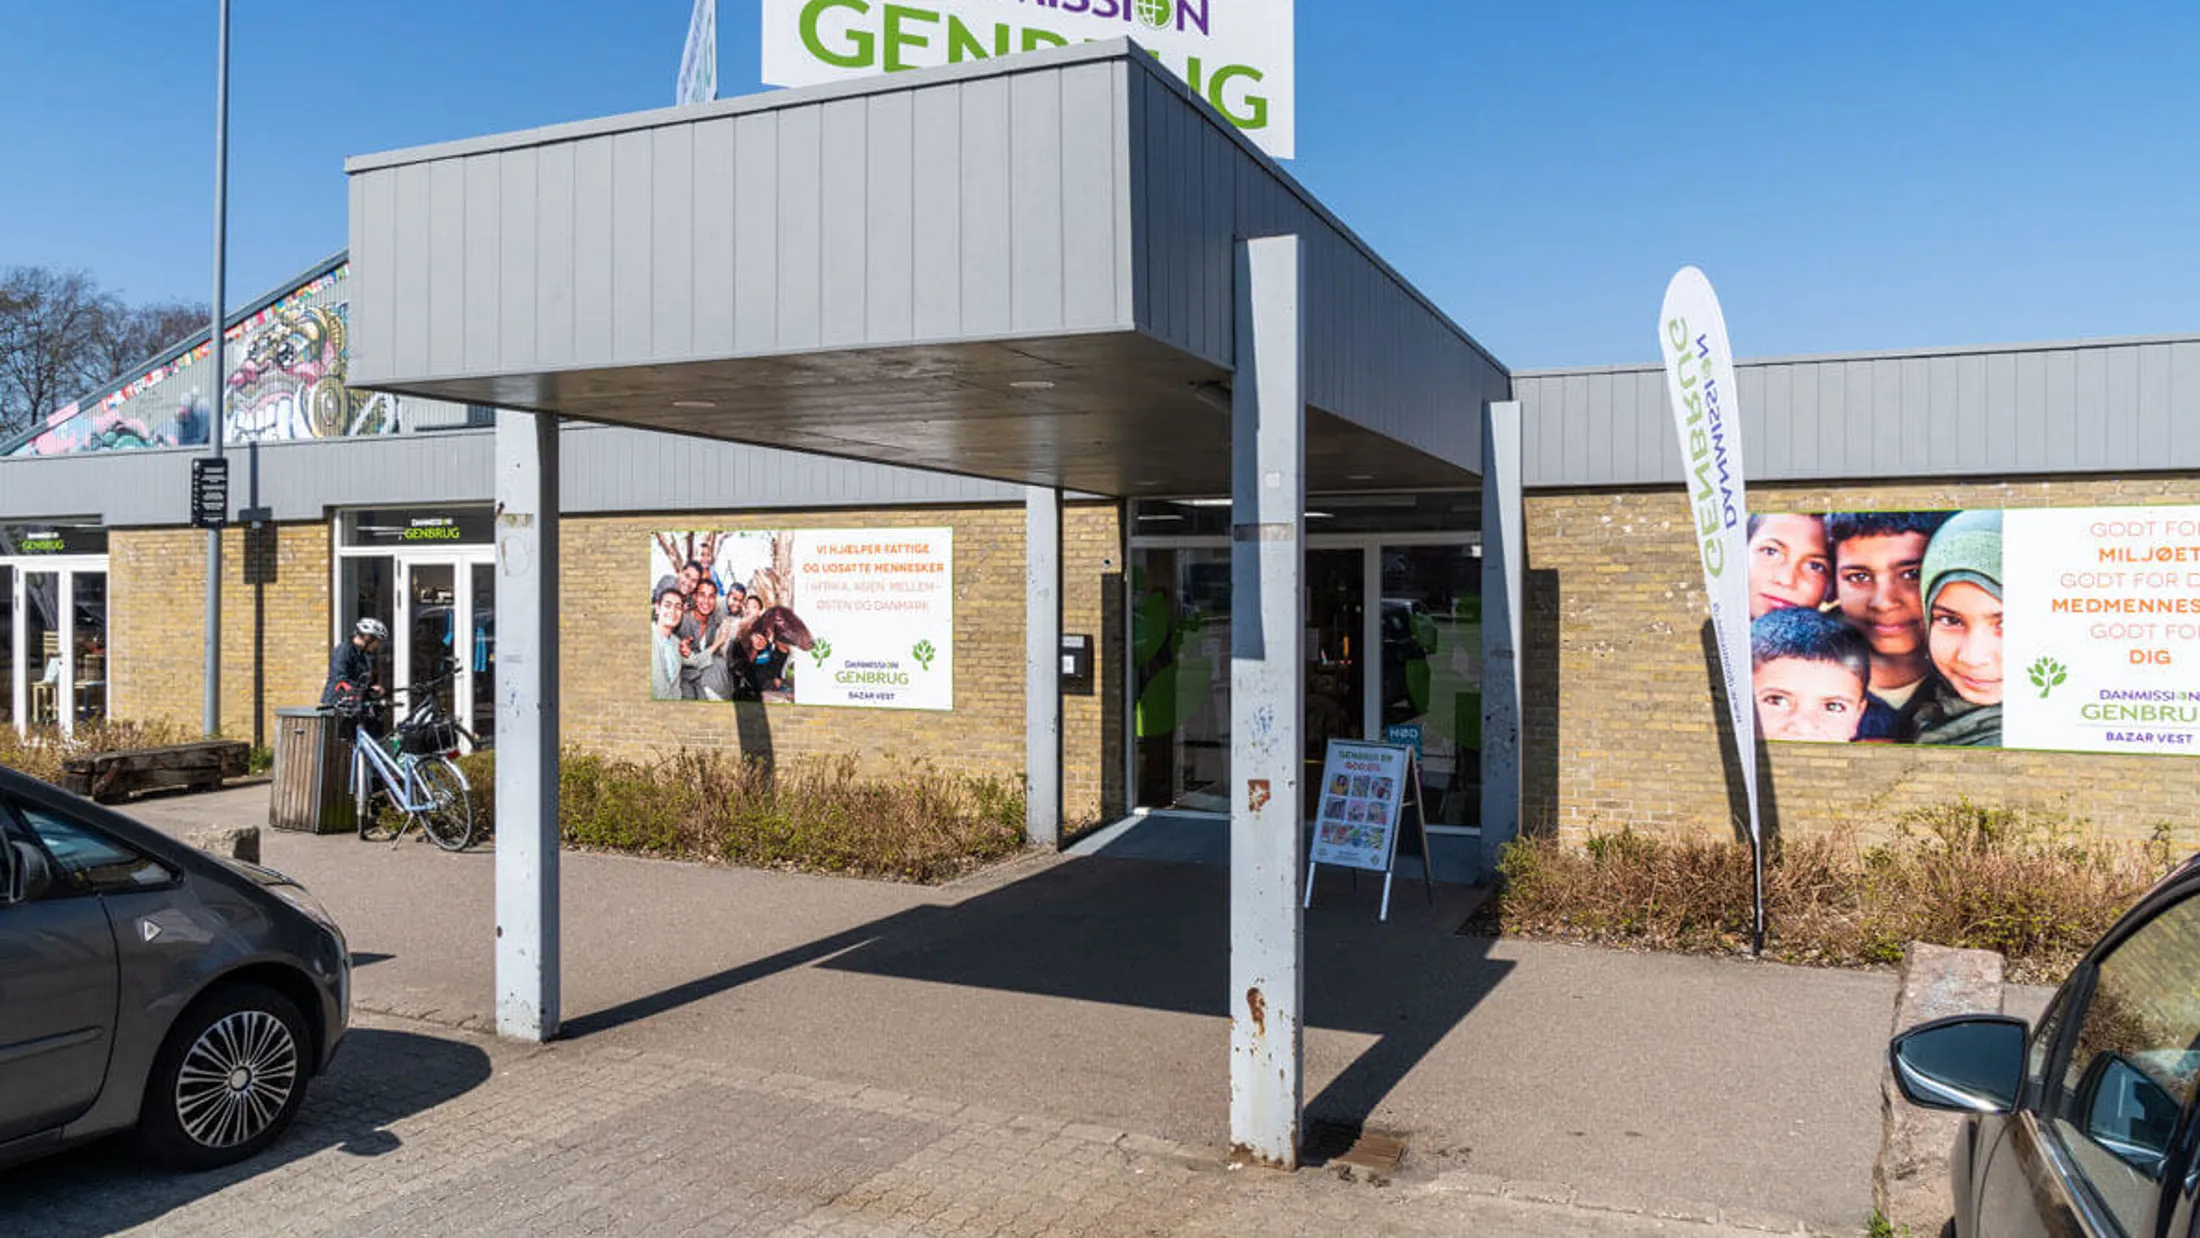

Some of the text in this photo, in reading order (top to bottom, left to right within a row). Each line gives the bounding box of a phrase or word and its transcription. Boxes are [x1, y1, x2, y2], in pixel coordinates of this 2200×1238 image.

[2090, 521, 2200, 537] GODT FO
[2099, 546, 2200, 562] MILJØET
[2060, 572, 2126, 589] GODT
[2134, 572, 2178, 588] FOR
[2089, 623, 2200, 640] GODT FO
[2129, 649, 2171, 665] DIG
[834, 670, 909, 685] GENBRUG
[2105, 731, 2193, 744] BAZAR VEST
